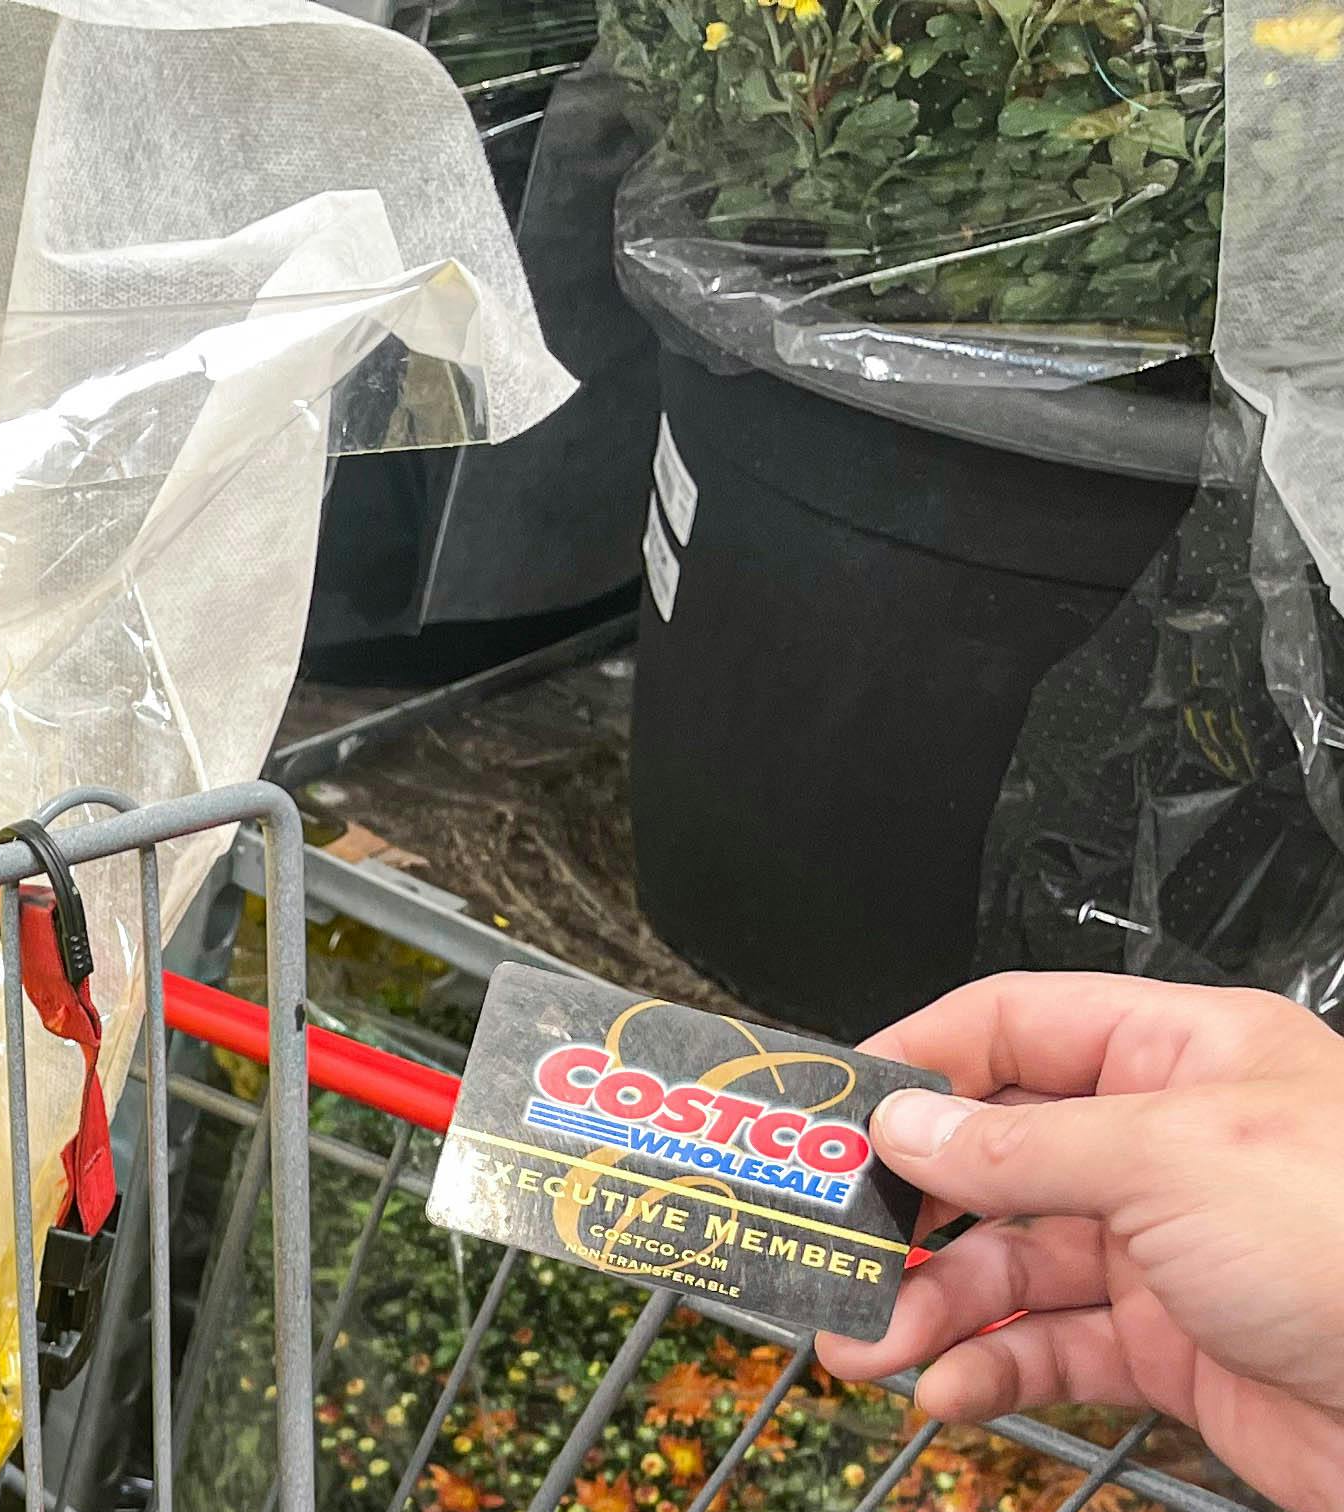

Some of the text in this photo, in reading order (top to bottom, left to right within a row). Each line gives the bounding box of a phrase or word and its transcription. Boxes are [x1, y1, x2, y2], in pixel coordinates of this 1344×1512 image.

[538, 1046, 870, 1175] COSTCO
[626, 1127, 852, 1206] WHOLESALE
[564, 1241, 742, 1299] NON-TRANSFERABLE
[588, 1223, 730, 1273] COSTCO.COM
[703, 1214, 885, 1285] MEMBER
